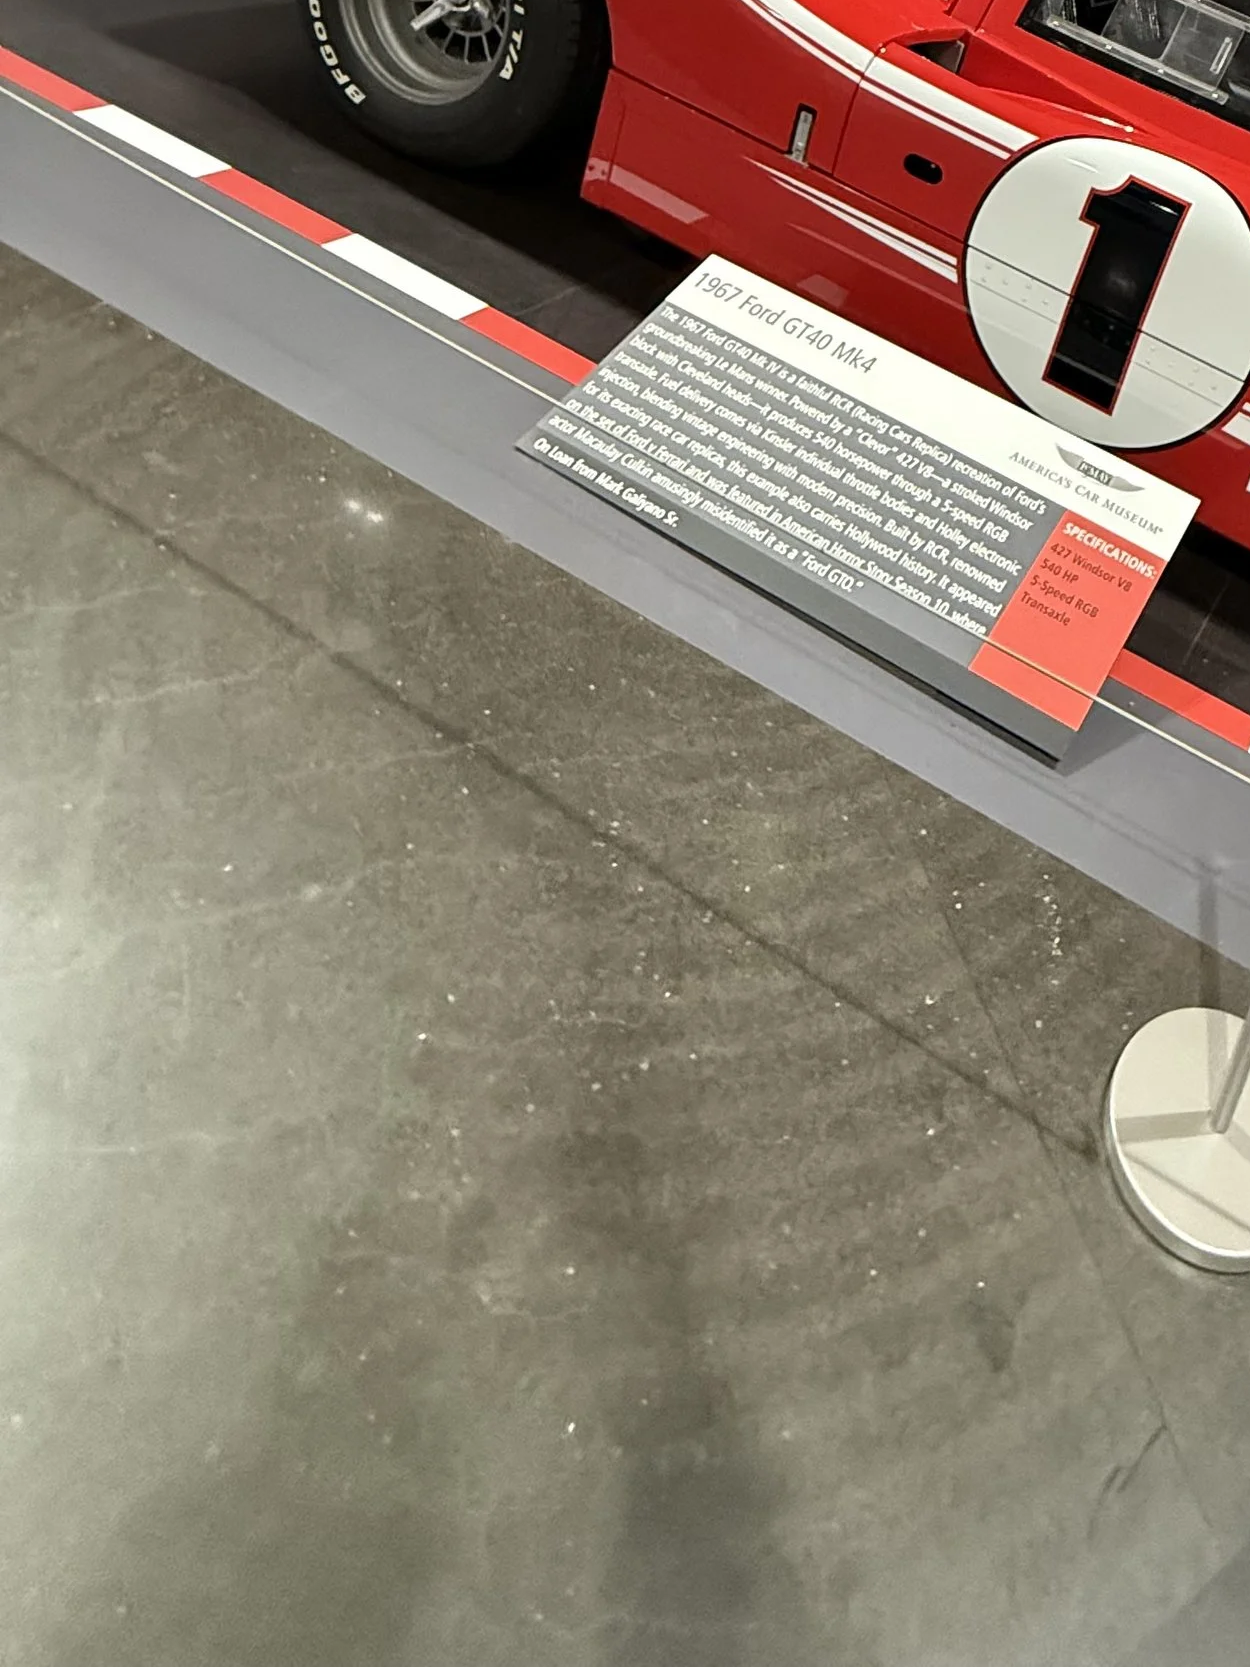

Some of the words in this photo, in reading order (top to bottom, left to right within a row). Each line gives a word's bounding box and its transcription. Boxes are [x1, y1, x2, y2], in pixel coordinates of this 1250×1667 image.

[499, 29, 524, 80] T/A
[695, 272, 744, 302] 1967
[739, 294, 786, 325] Ford
[784, 317, 833, 350] GT40
[831, 341, 878, 373] Mk4
[1041, 175, 1192, 416] 1
[629, 333, 658, 355] block
[656, 349, 679, 366] with
[678, 360, 727, 390] Cleveland
[766, 410, 815, 439] produces
[812, 431, 837, 450] 540
[833, 441, 894, 480] horsepower
[891, 473, 933, 502] through
[941, 498, 986, 529] 5-speed
[983, 521, 1010, 542] RGB
[643, 322, 718, 366] groundbreaking
[727, 363, 757, 384] Mans
[755, 378, 790, 402] winner.
[788, 394, 834, 424] Powered
[896, 452, 920, 469] 427
[950, 482, 993, 508] stroked
[989, 499, 1034, 530] Windsor
[660, 305, 680, 322] The
[679, 315, 707, 333] 1967
[702, 328, 728, 346] Ford
[724, 339, 753, 359] GT40
[749, 352, 768, 368] Mk
[796, 375, 834, 401] faithful
[829, 393, 855, 412] RCR
[851, 405, 890, 434] (Racing
[889, 424, 913, 444] Cars
[911, 436, 954, 465] Replica)
[951, 459, 1003, 491] recreation
[533, 437, 552, 453] On
[548, 445, 575, 467] Loan
[572, 458, 598, 480] from
[595, 471, 625, 495] Mark
[548, 415, 578, 434] actor
[574, 426, 624, 462] Macaulay
[621, 453, 654, 478] Culkin
[651, 472, 704, 508] amusingly
[700, 499, 770, 541] misidentified
[773, 540, 791, 554] as
[583, 380, 601, 395] for
[610, 397, 653, 427] exacting
[649, 419, 674, 436] race
[671, 431, 691, 445] car
[687, 439, 727, 468] replicas,
[726, 460, 749, 478] this
[746, 471, 790, 501] example
[788, 495, 812, 512] also
[811, 507, 847, 532] carries
[844, 522, 903, 561] Hollywood
[898, 552, 938, 584] history.
[948, 582, 1003, 617] appeared
[598, 365, 641, 396] injection,
[640, 386, 684, 419] blending
[682, 411, 720, 436] vintage
[717, 430, 776, 469] engineering
[774, 461, 799, 479] with
[833, 494, 883, 527] precision.
[883, 518, 912, 541] Built
[908, 531, 926, 551] by
[923, 539, 950, 565] RCR,
[950, 557, 1008, 592] renowned
[614, 350, 659, 380] transaxle.
[657, 372, 684, 391] Fuel
[678, 384, 718, 412] delivery
[715, 405, 748, 427] comes
[761, 428, 798, 453] Kinsler
[794, 445, 847, 479] individual
[843, 472, 882, 499] throttle
[880, 490, 916, 518] bodies
[914, 512, 940, 529] and
[936, 521, 971, 549] Holley
[969, 541, 1023, 575] electronic
[1075, 484, 1100, 503] CAR
[1030, 574, 1076, 605] 5-Speed
[1075, 598, 1100, 617] RGB
[1040, 557, 1063, 575] 540
[1051, 542, 1073, 558] 427
[1073, 552, 1116, 582] Windsor
[1063, 522, 1158, 579] SPECIFICATIONS:
[1021, 590, 1071, 626] Transaxle
